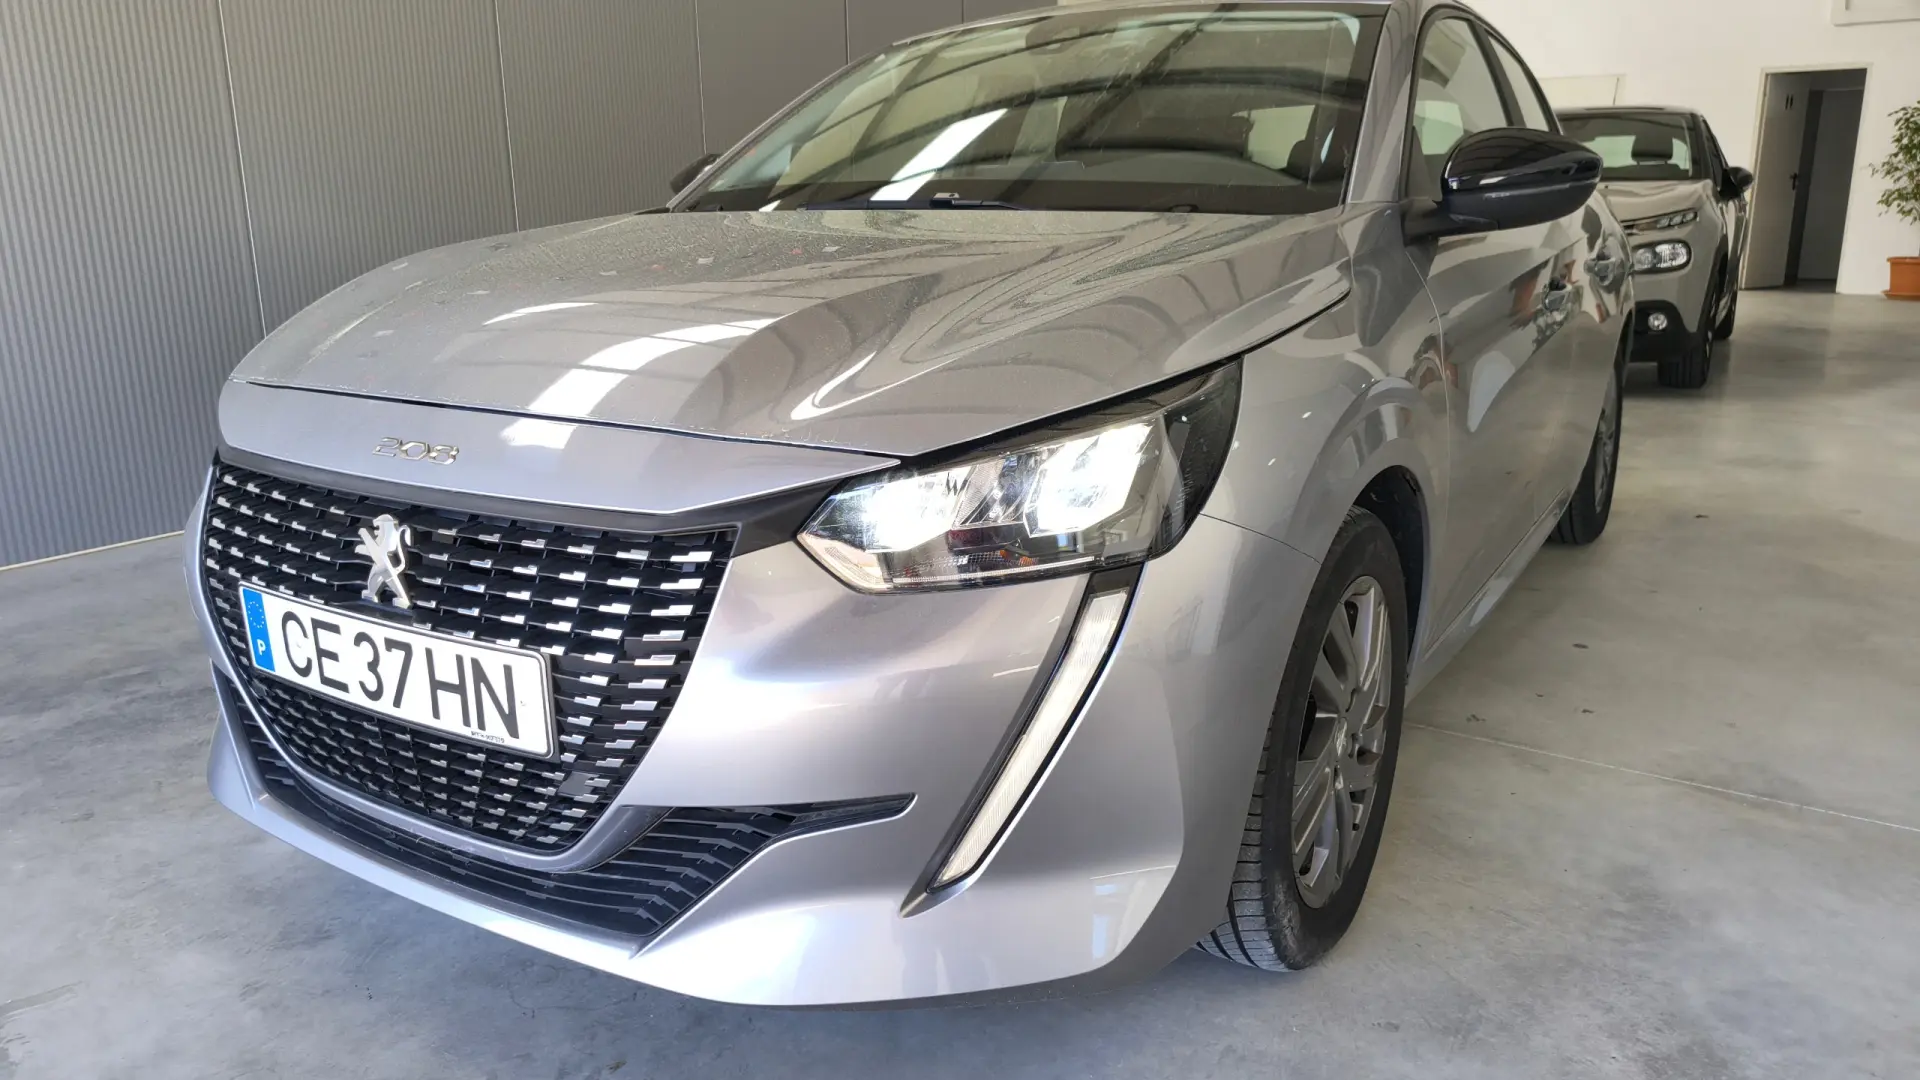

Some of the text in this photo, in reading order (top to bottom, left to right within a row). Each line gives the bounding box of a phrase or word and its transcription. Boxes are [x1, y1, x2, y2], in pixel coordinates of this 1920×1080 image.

[372, 436, 459, 465] 208
[257, 639, 266, 656] P
[281, 610, 519, 739] CE 37 HN
